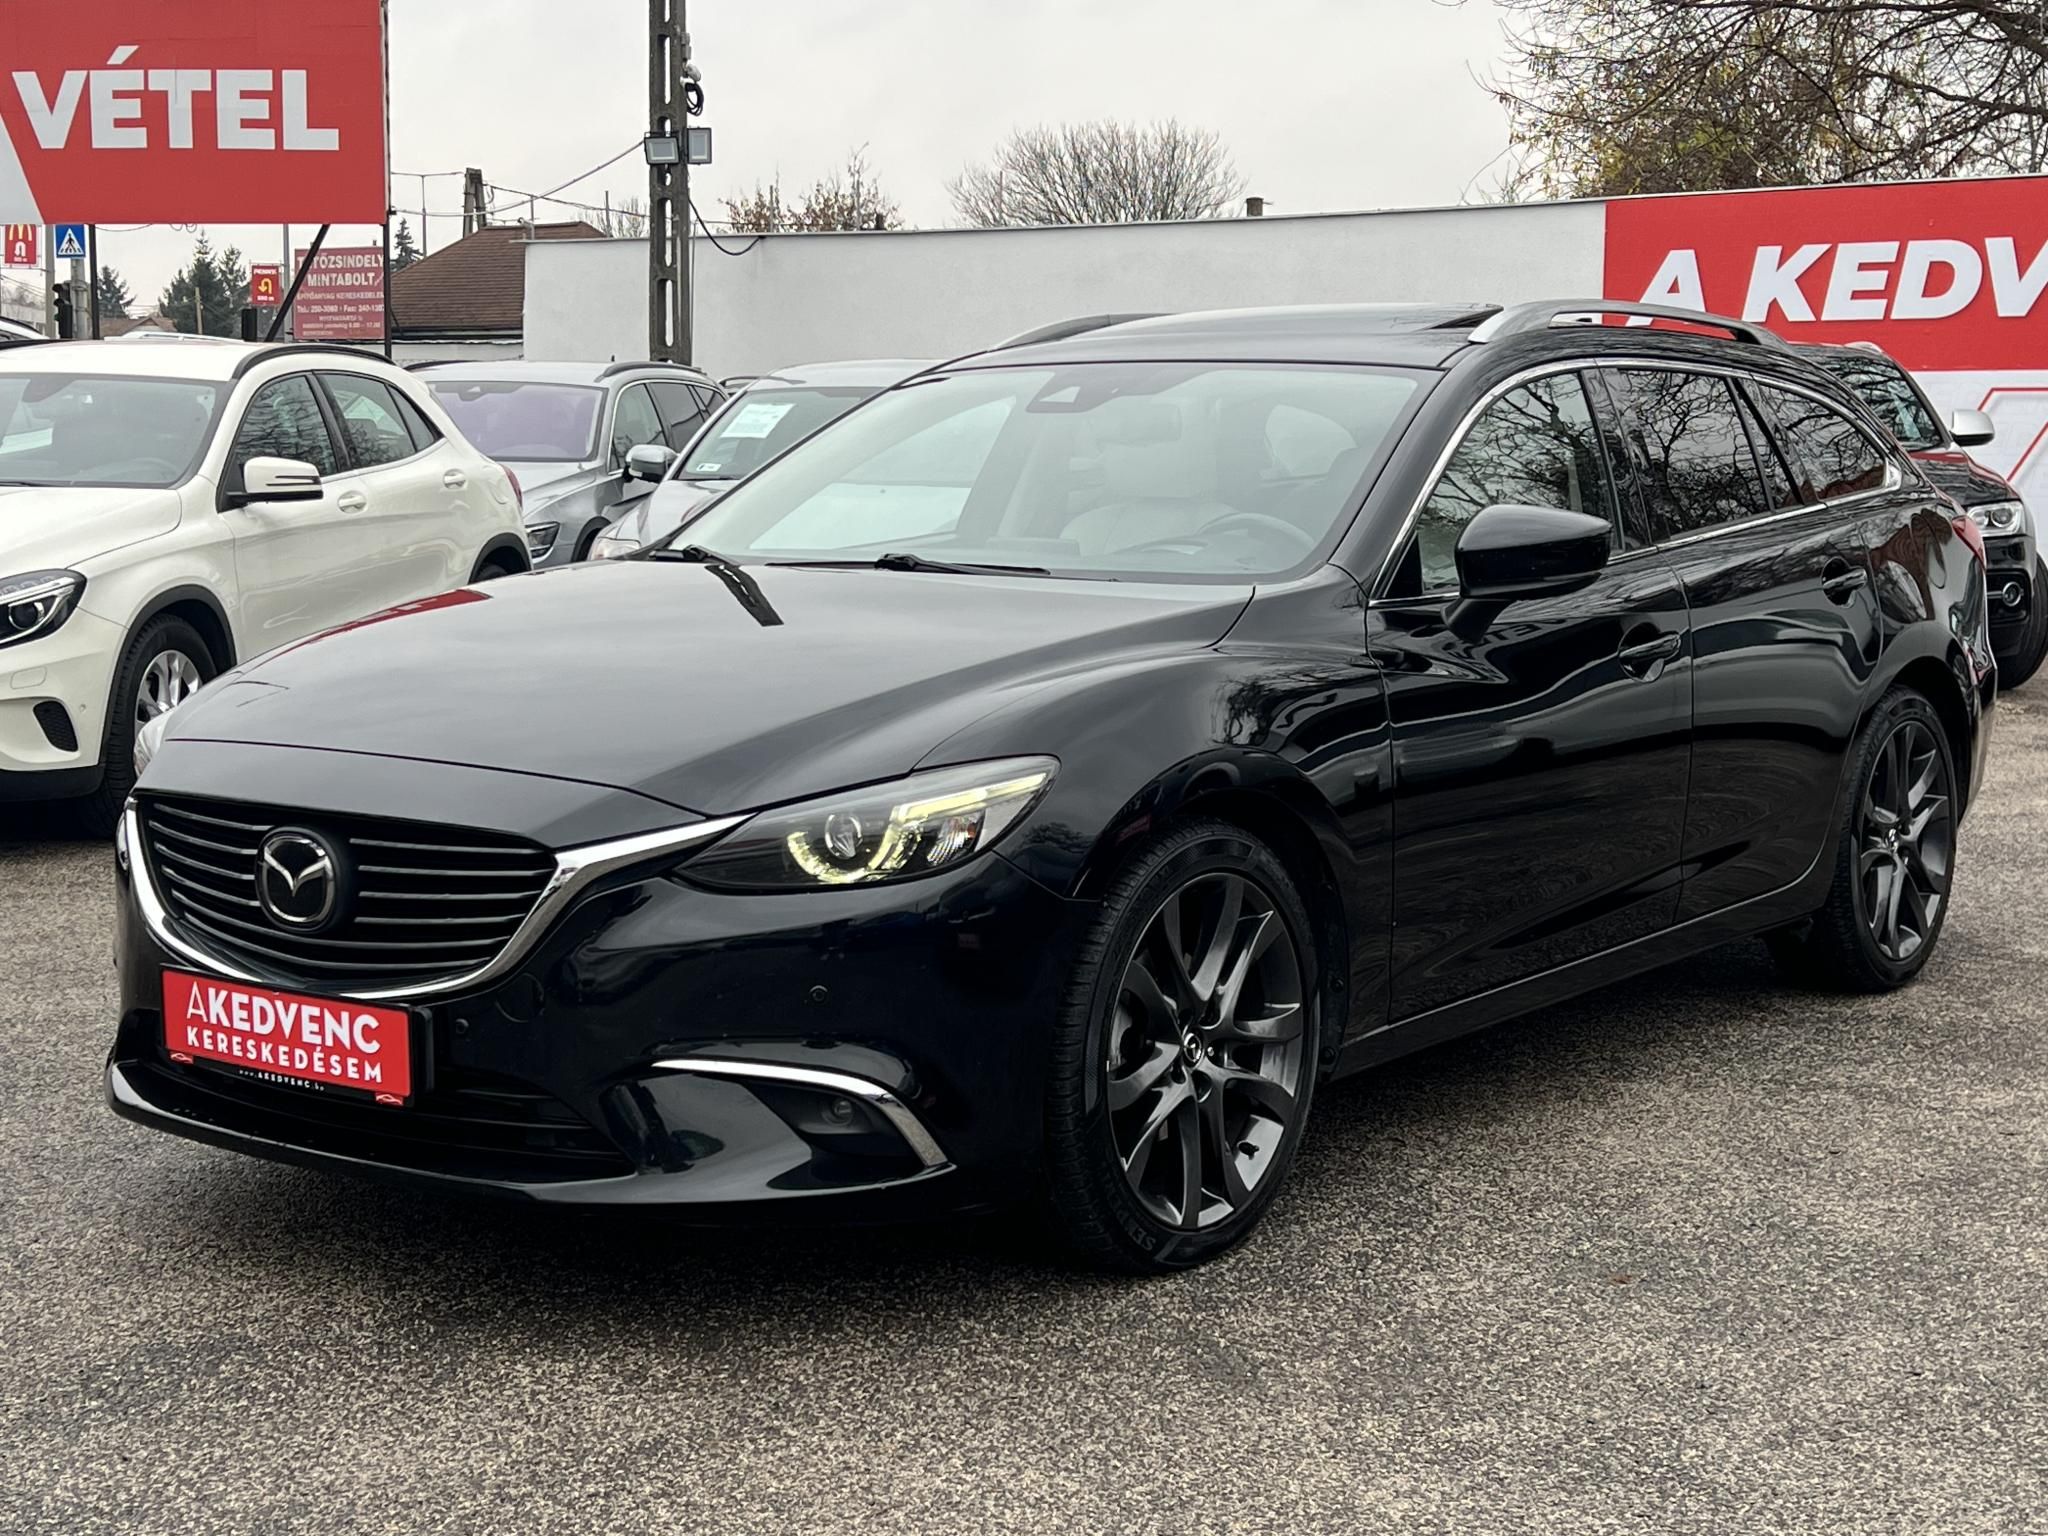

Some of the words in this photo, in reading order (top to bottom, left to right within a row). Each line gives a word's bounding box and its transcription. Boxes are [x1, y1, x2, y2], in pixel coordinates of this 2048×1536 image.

[11, 45, 340, 150] VÉTEL
[307, 272, 376, 287] MINTABOLT
[1625, 248, 1706, 327] A
[1742, 236, 2048, 322] KEDV
[186, 1026, 383, 1084] KERESKEDÉSEM
